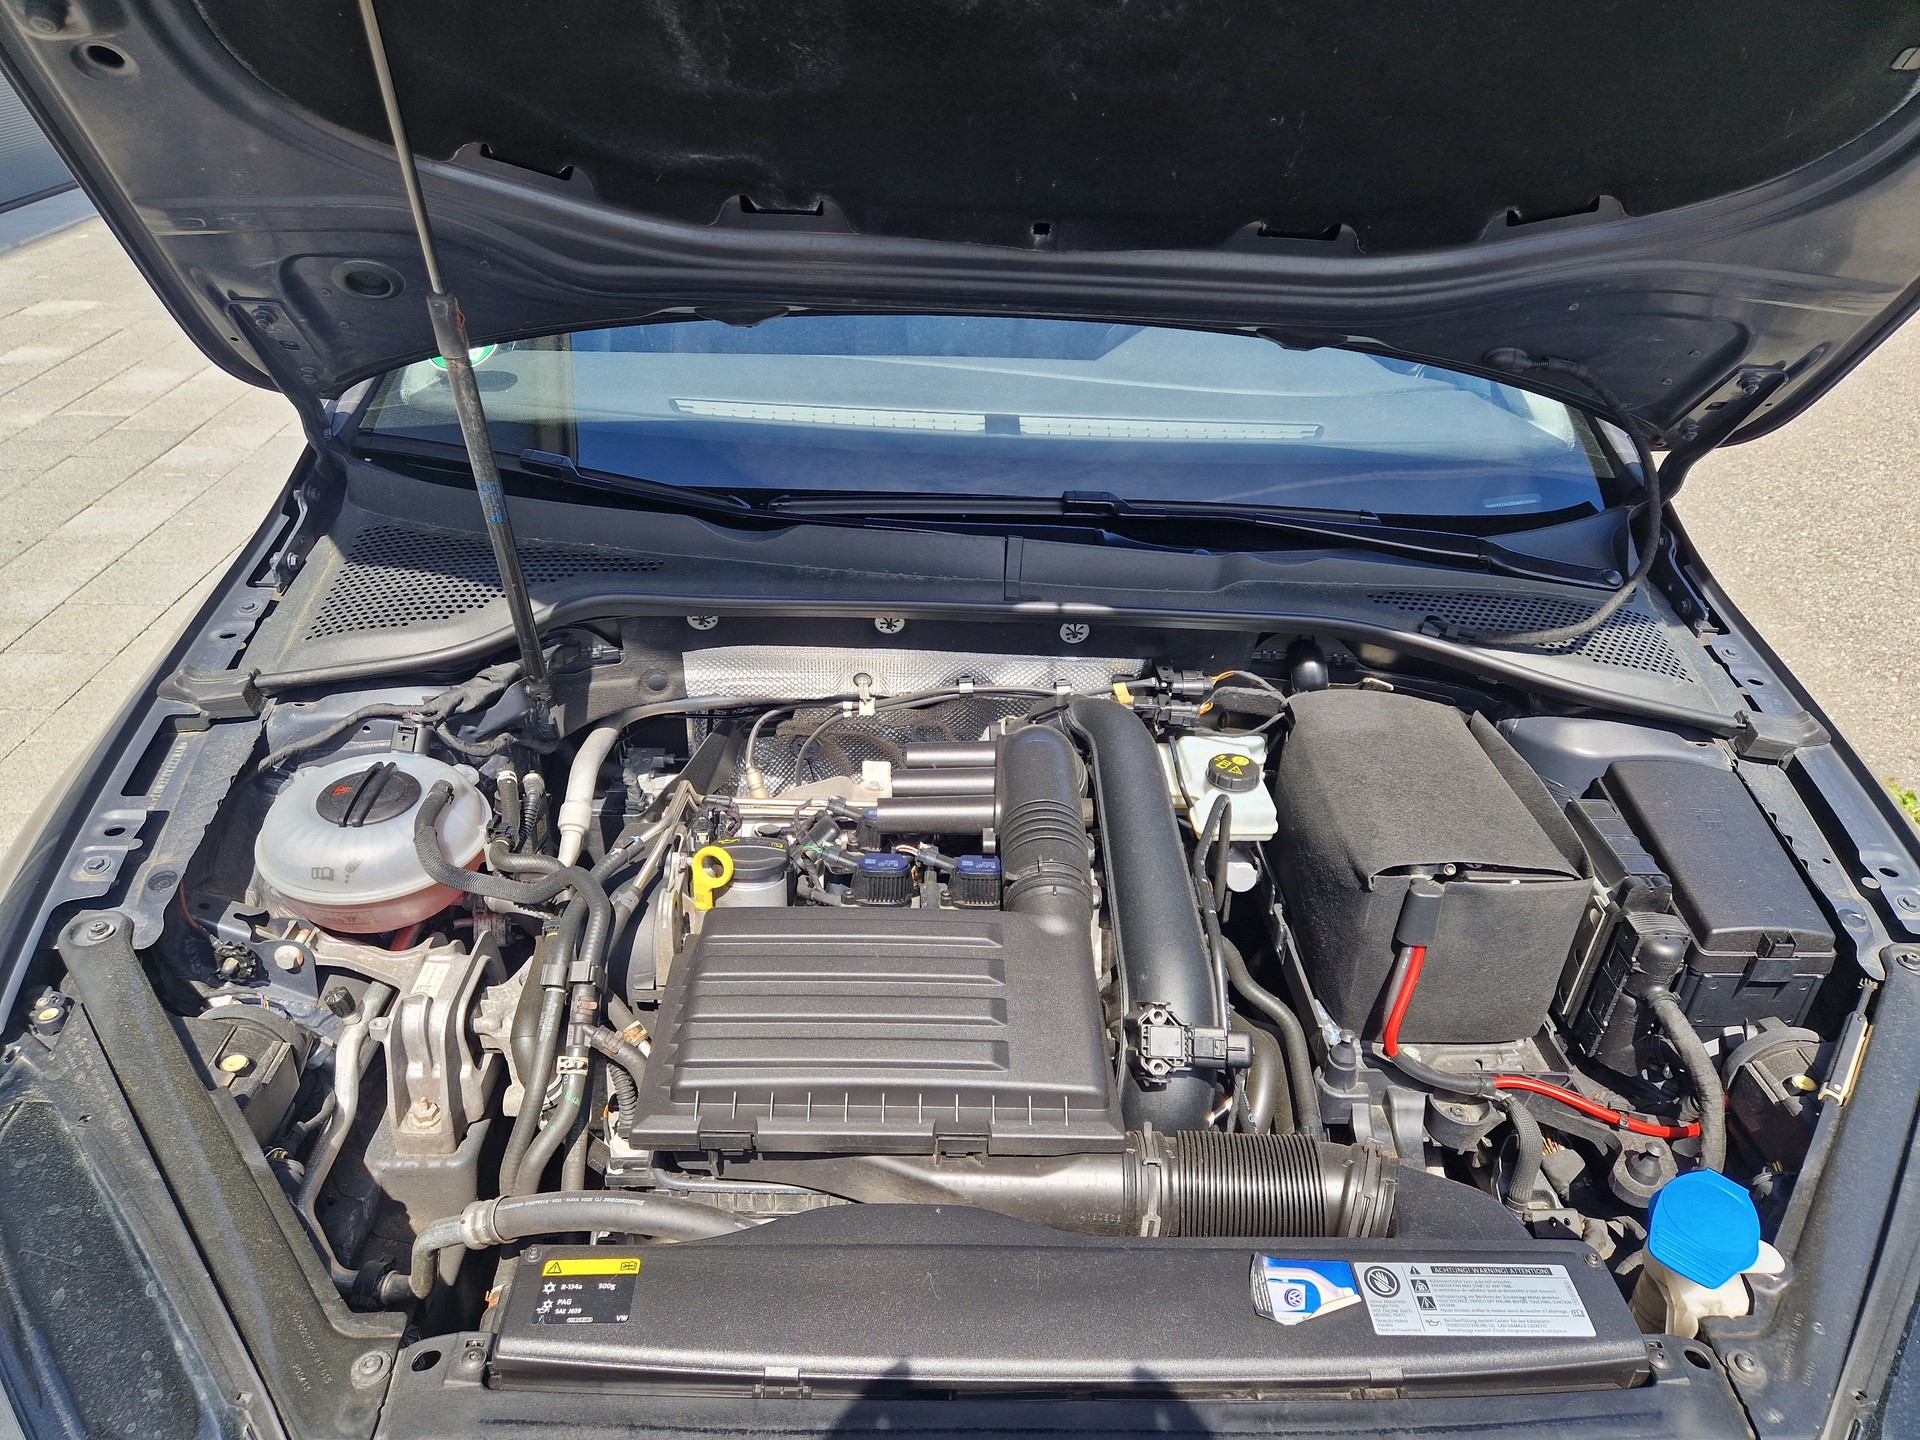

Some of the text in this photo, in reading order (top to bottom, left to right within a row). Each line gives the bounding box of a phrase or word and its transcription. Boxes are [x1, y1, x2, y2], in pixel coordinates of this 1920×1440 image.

[1472, 1267, 1510, 1275] WARNING!
[1510, 1267, 1551, 1275] ATTENTION!
[561, 1283, 617, 1291] R-134a 500g
